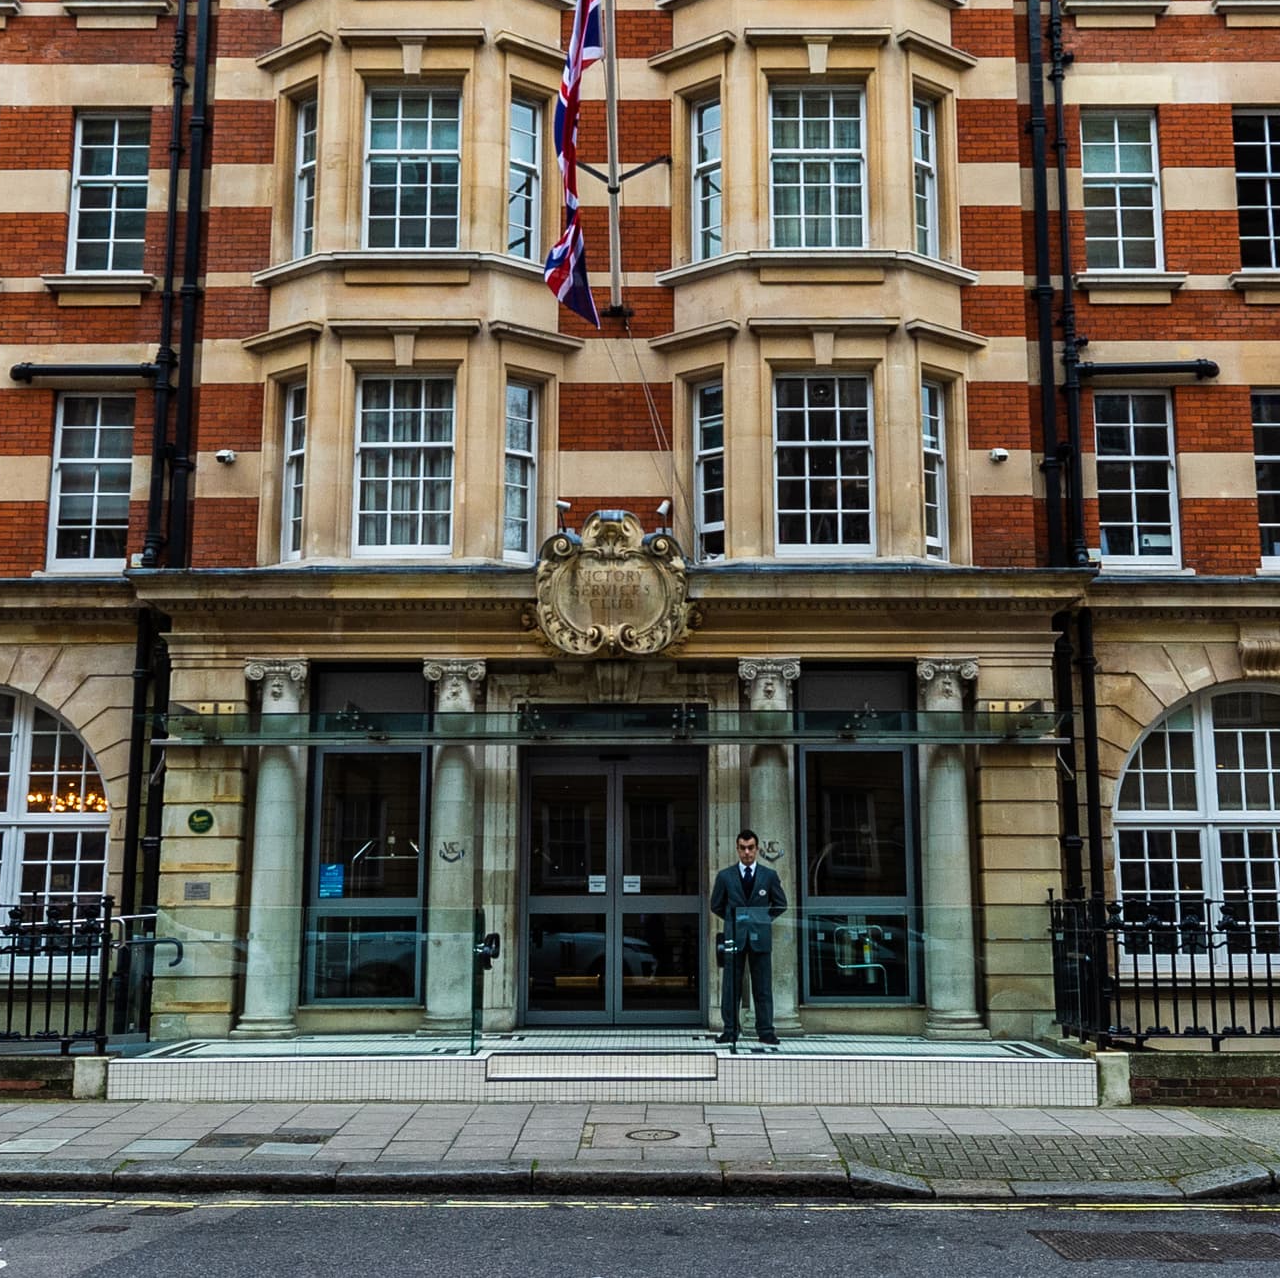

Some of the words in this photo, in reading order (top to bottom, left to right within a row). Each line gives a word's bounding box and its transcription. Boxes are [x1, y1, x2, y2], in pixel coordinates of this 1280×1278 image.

[577, 570, 643, 583] VICTORY
[570, 584, 651, 597] SERVICES
[589, 598, 635, 610] CLUB
